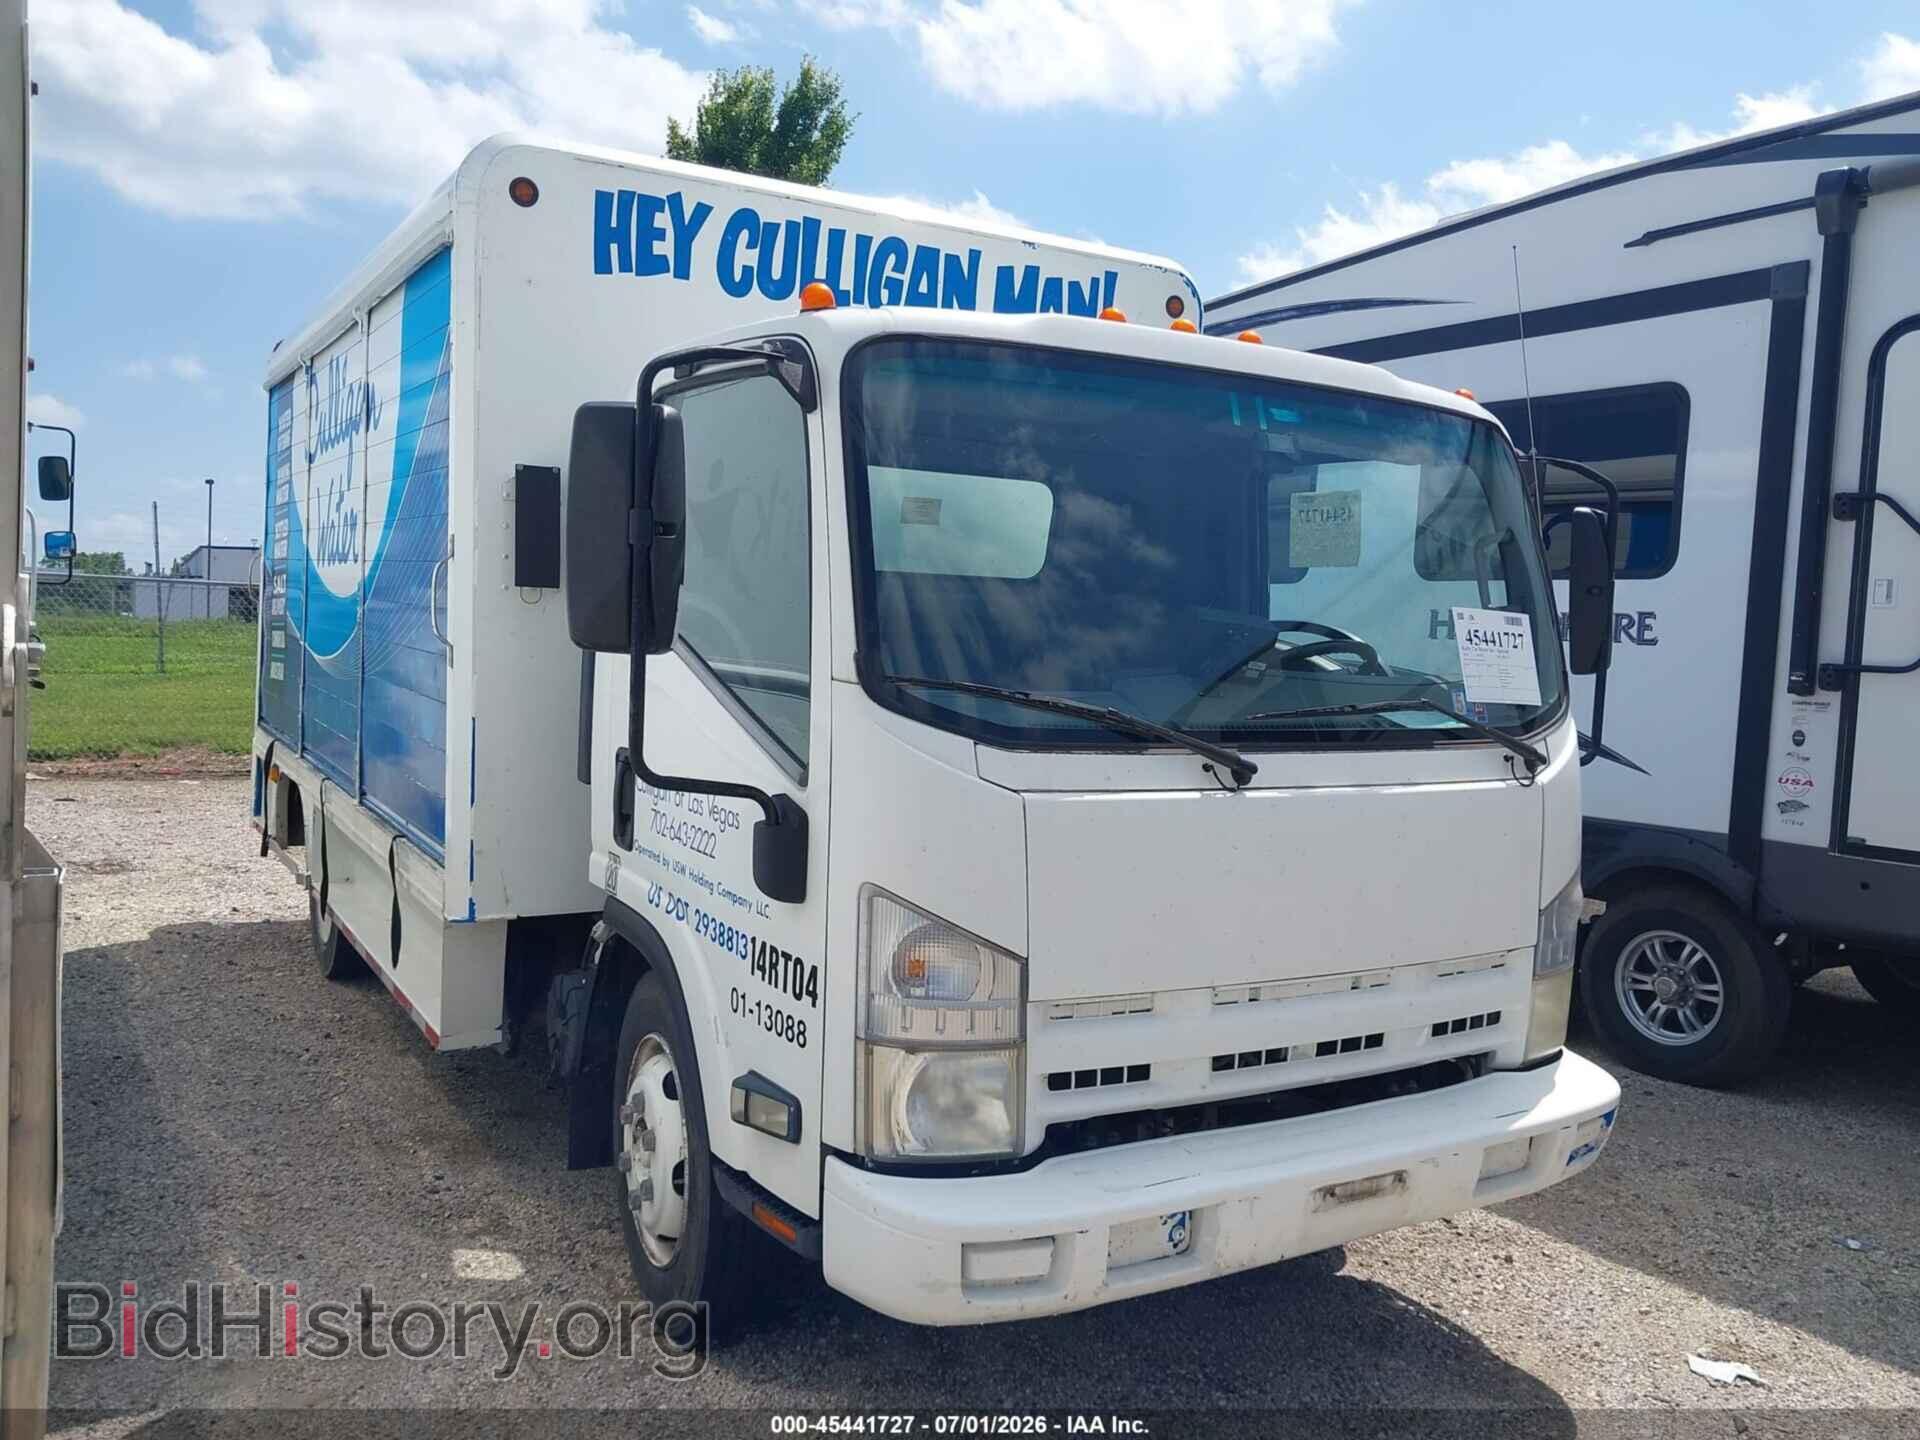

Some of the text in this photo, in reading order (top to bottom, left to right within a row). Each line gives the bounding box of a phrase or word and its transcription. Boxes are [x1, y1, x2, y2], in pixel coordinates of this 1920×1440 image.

[594, 189, 714, 280] HEY
[716, 207, 982, 311] CULLIGAN
[316, 474, 359, 568] Water
[1465, 628, 1524, 649] 45441727
[688, 792, 704, 816] Las
[707, 794, 741, 832] Vegas
[1777, 777, 1815, 787] USA
[650, 808, 717, 859] 702-643-2222
[634, 839, 661, 863] Operated
[662, 852, 671, 872] by
[689, 867, 714, 895] Holding
[717, 882, 752, 913] Company
[648, 881, 748, 961] US DOT 2938813
[750, 936, 818, 1008] 14RT04
[730, 987, 807, 1048] 01-13088
